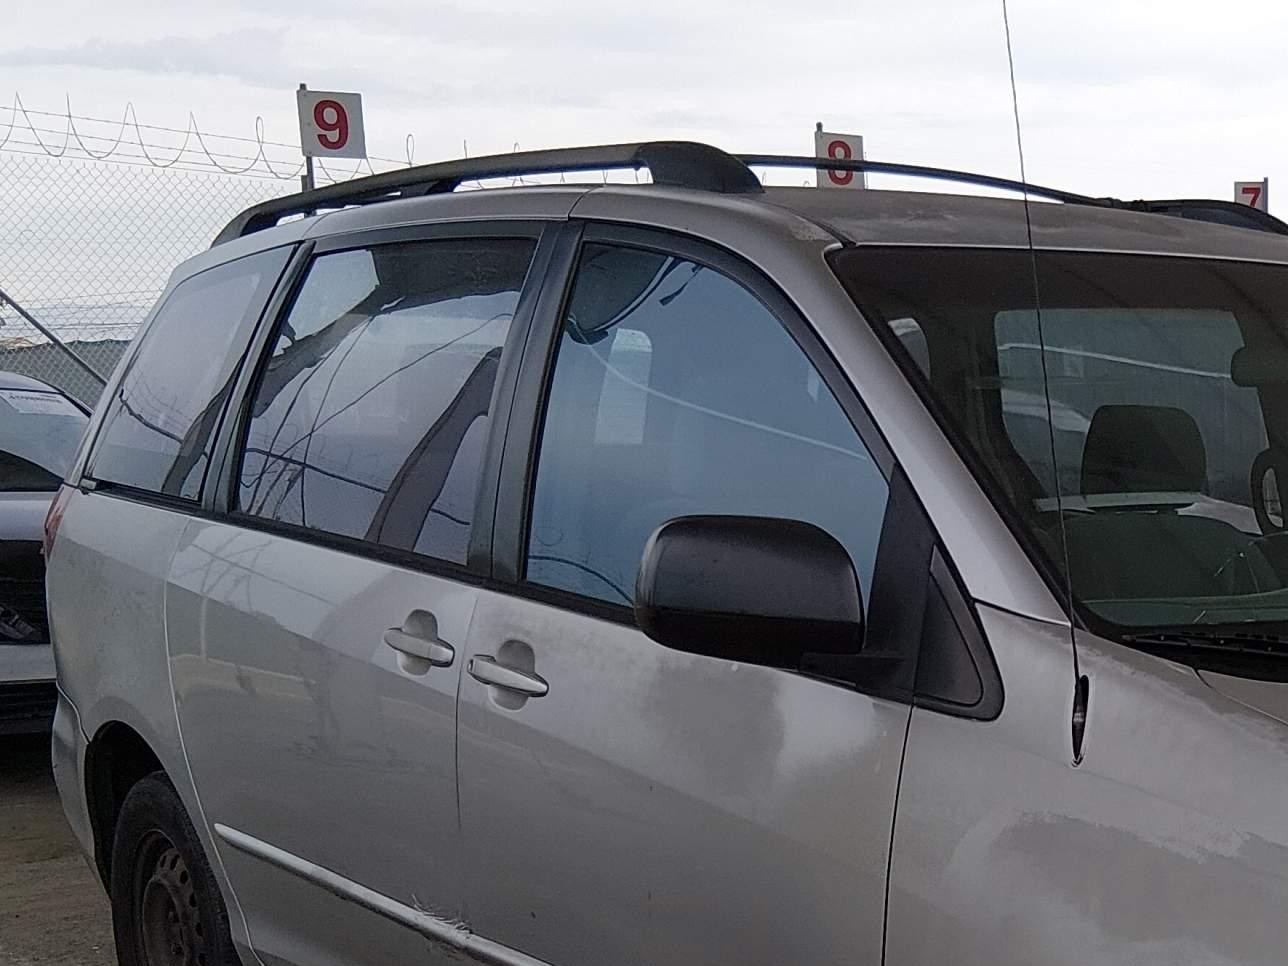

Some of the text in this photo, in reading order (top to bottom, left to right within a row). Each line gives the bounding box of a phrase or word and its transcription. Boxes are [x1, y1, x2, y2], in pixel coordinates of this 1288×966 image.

[314, 99, 349, 150] 9
[827, 140, 854, 186] 8
[1242, 187, 1261, 208] 7
